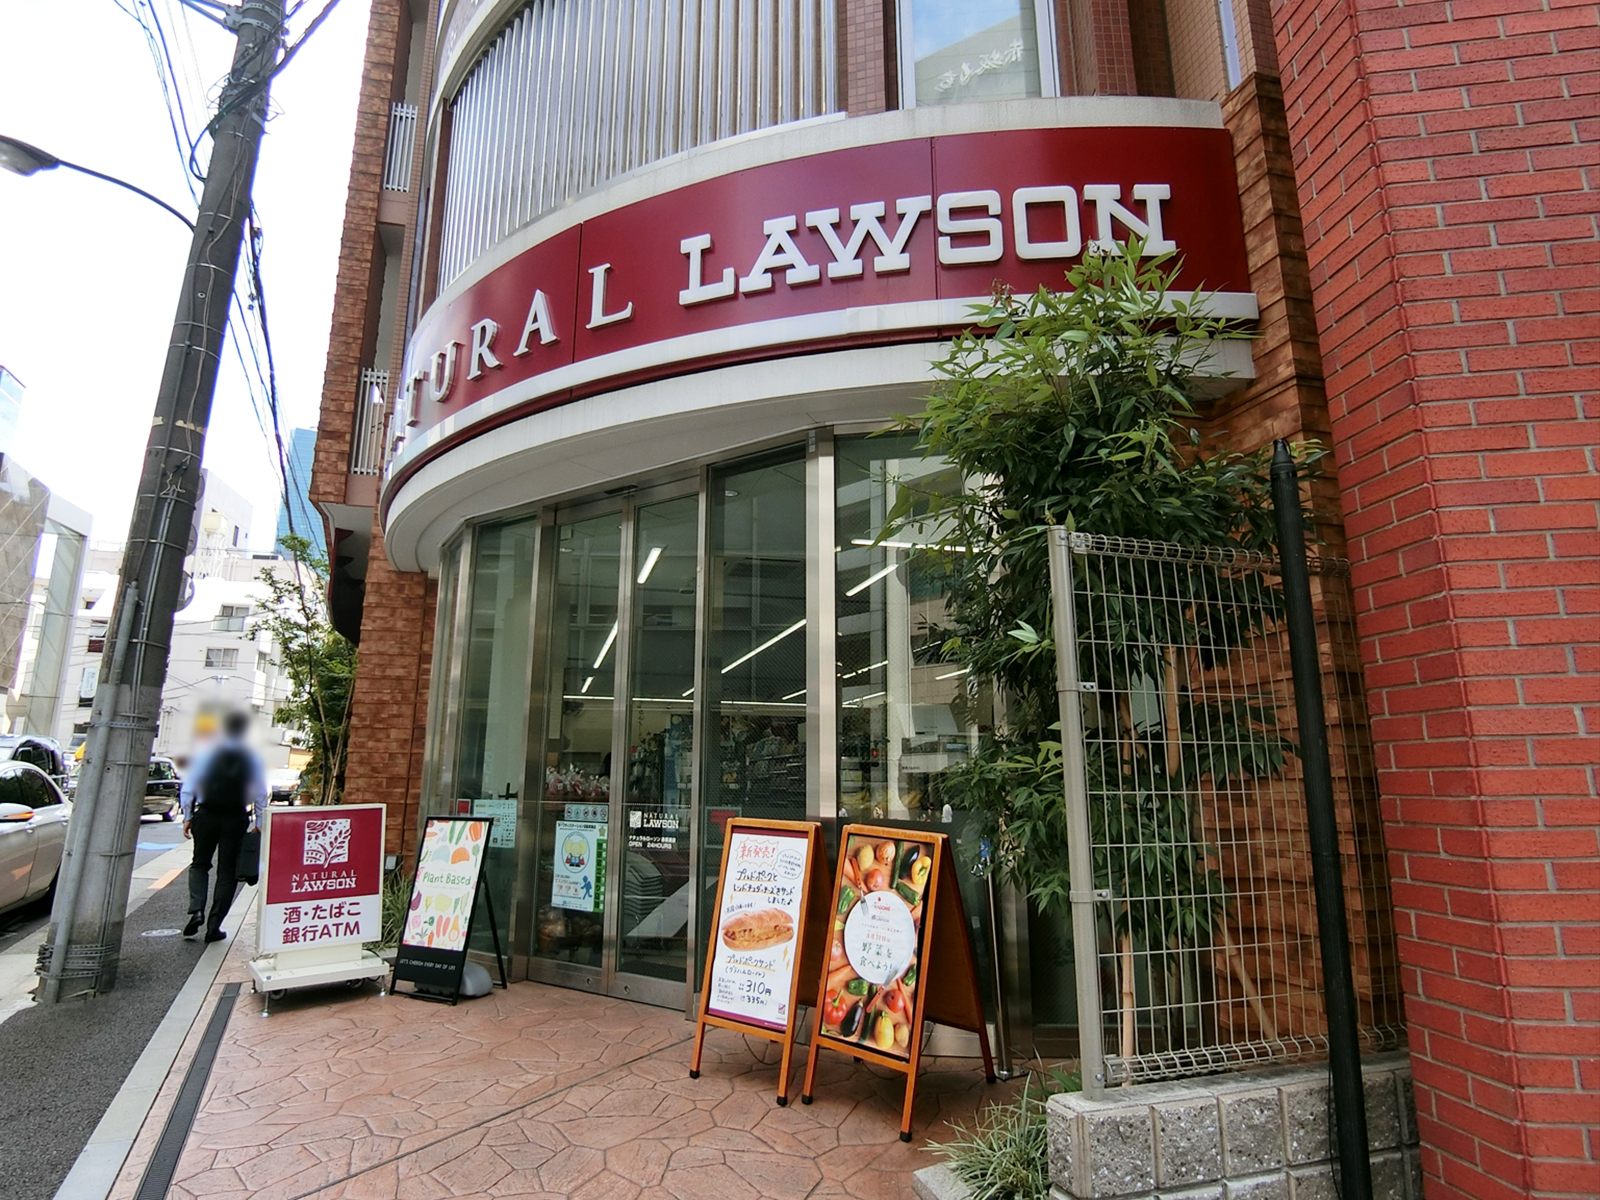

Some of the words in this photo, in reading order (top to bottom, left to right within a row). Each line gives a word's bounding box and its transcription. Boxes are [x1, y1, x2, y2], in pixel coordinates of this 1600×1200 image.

[389, 262, 635, 440] TURAL
[679, 183, 1178, 307] LAWSON
[642, 818, 680, 829] LAWSON
[643, 811, 680, 820] NATURAL
[628, 840, 643, 848] OPEN
[646, 841, 672, 850] 24HOURS
[291, 869, 357, 882] NATURAL
[422, 871, 444, 884] Plant
[445, 873, 472, 886] Based
[291, 877, 357, 893] LAWSON
[282, 901, 362, 925] 酒・たばこ
[281, 920, 361, 945] 銀行ATM
[862, 941, 893, 959] 野菜を
[746, 979, 772, 997] 310円
